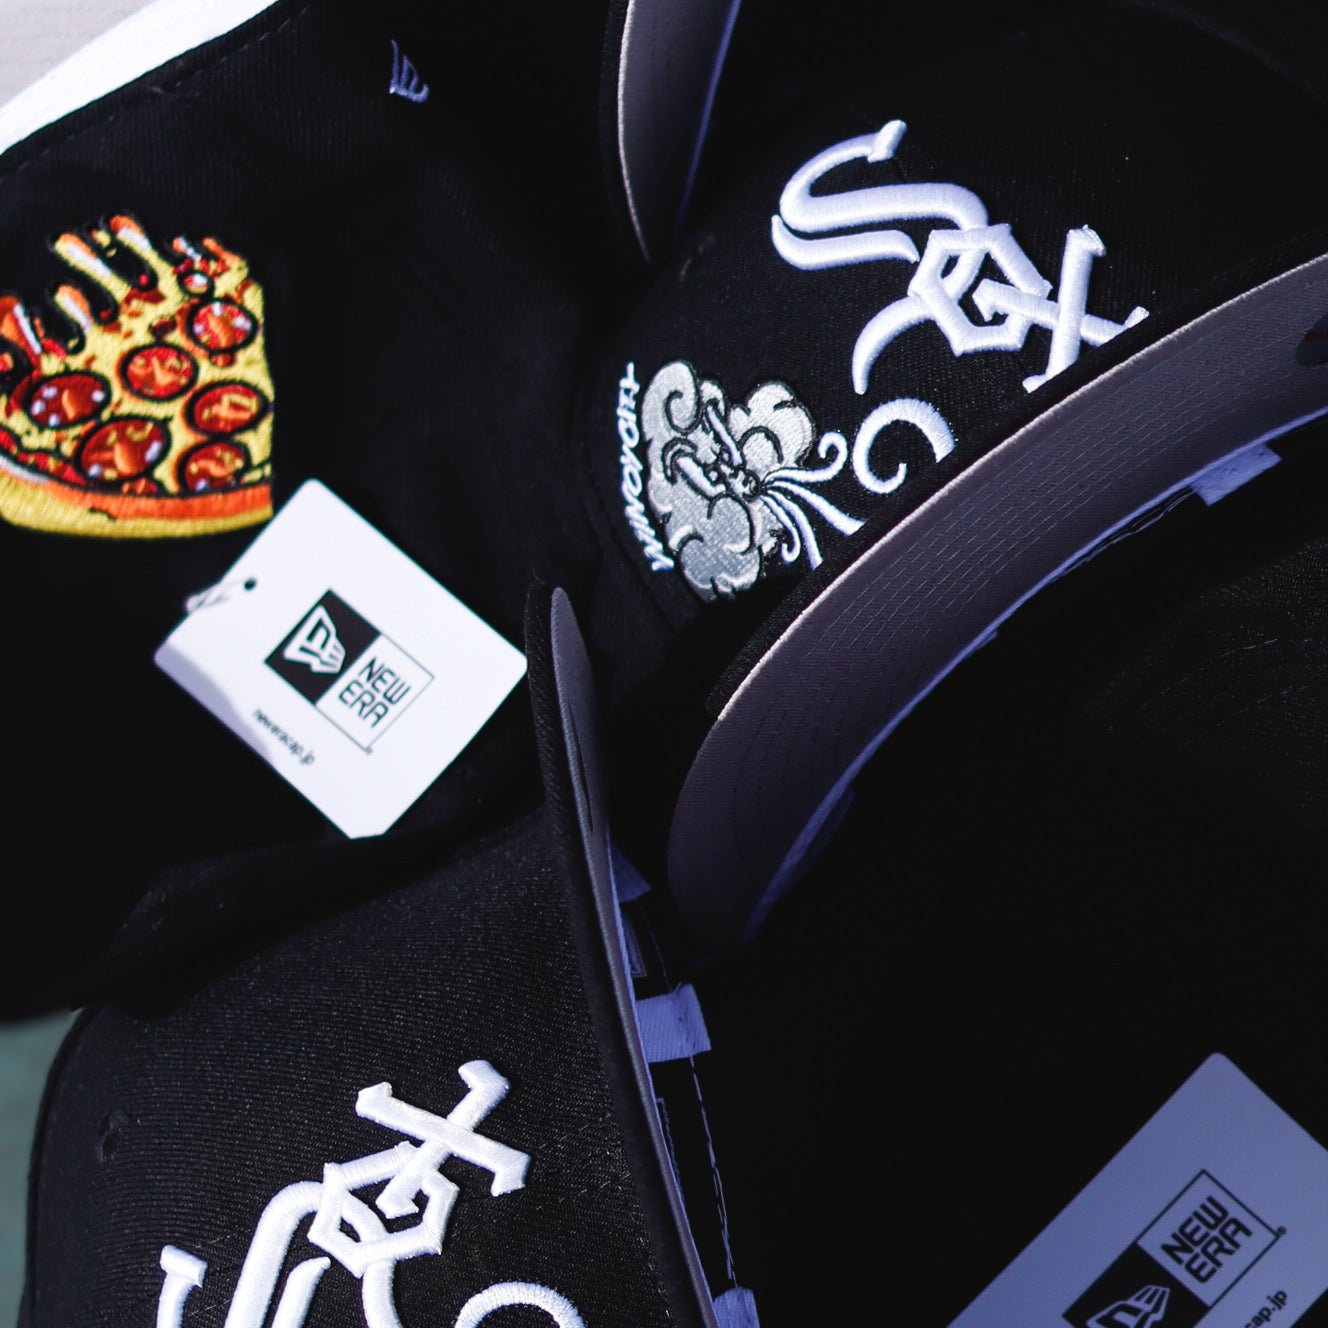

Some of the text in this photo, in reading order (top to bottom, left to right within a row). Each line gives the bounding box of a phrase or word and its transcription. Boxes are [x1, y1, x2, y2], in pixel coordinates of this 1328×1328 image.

[339, 679, 389, 728] ERA
[358, 657, 411, 705] NEW
[253, 709, 315, 765] neweracap.jp
[1161, 1196, 1229, 1265] NEW
[1185, 1218, 1252, 1283] ERA
